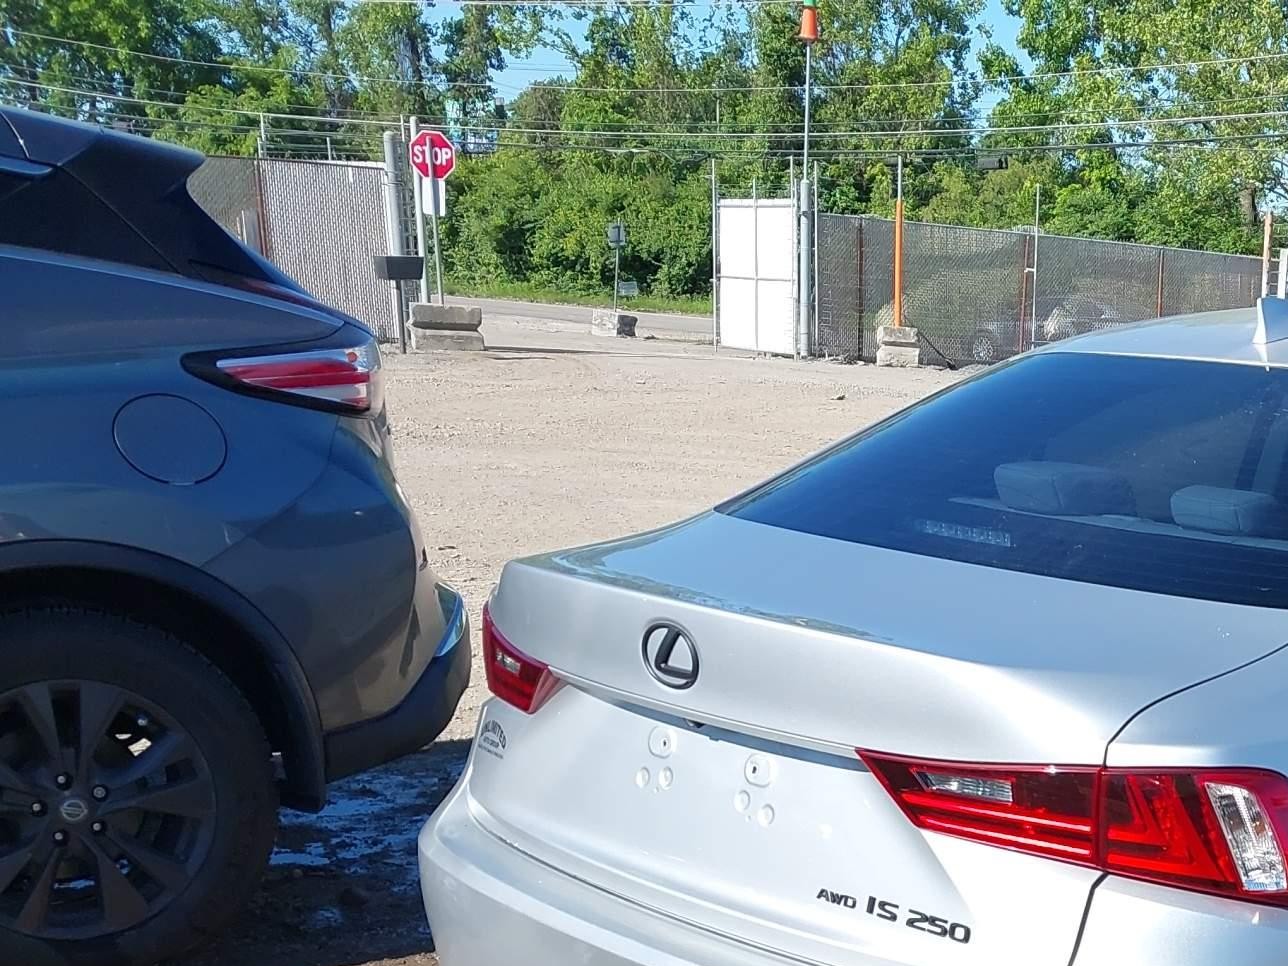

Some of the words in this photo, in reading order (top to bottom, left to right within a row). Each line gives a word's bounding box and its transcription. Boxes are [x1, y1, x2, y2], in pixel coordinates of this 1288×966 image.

[816, 888, 857, 909] AWD
[866, 895, 899, 922] IS
[906, 909, 971, 944] 250
